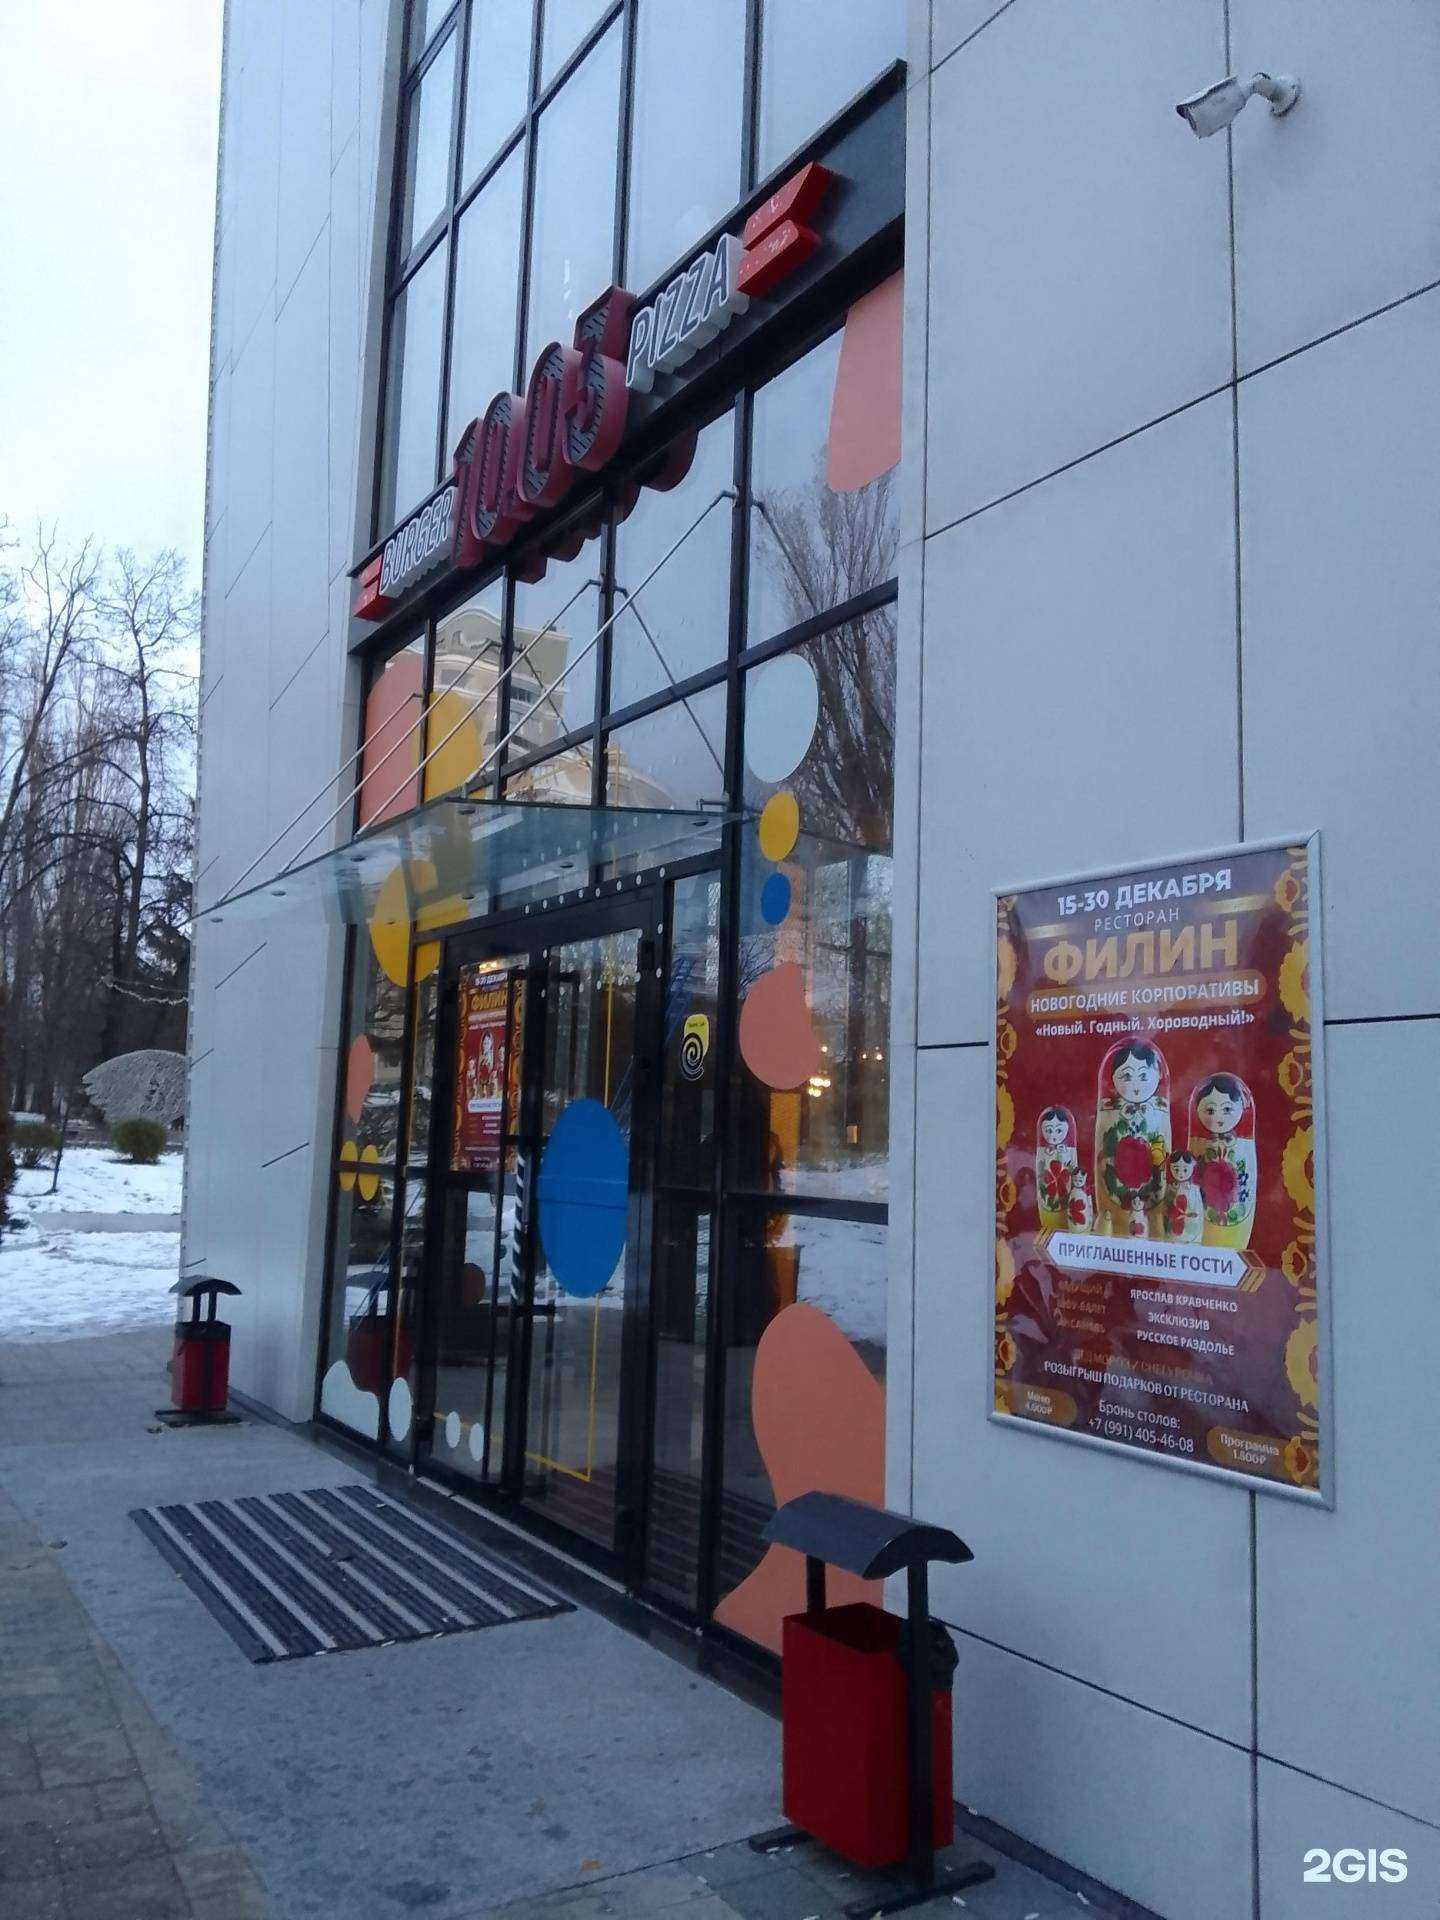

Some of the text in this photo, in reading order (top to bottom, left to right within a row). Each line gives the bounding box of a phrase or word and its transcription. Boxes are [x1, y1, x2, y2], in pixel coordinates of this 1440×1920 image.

[626, 233, 740, 391] PIZZA
[379, 486, 458, 599] BURGER
[1057, 868, 1232, 916] 15-30 ДЕКАБРЯ
[1094, 908, 1179, 932] РЕСТОРАН
[1043, 920, 1238, 985] ФИЛИН
[1031, 978, 1259, 1013] НОВОГОДНИЕ КОРПОРАТИВЫ
[1035, 1009, 1255, 1037] «Новый. Годный. Хороводный!»
[1058, 1243, 1233, 1275] ПРИГЛАШЕННЫЕ ГОСТИ
[1130, 1289, 1238, 1313] ЯРОСЛАВ КРАВЧЕНКО
[1147, 1312, 1210, 1331] ЭКСКЛЮЗИВ
[1136, 1330, 1235, 1357] РУССКОЕ РАЗДОЛЬЕ
[1044, 1360, 1249, 1412] РОЗЫГРЫШ ПОДАРКОВ ОТ РЕСТОРАНА
[1099, 1399, 1181, 1429] Бронь столов:
[1088, 1418, 1194, 1453] +7 (991) 405-46-08
[1219, 1433, 1280, 1457] Программа
